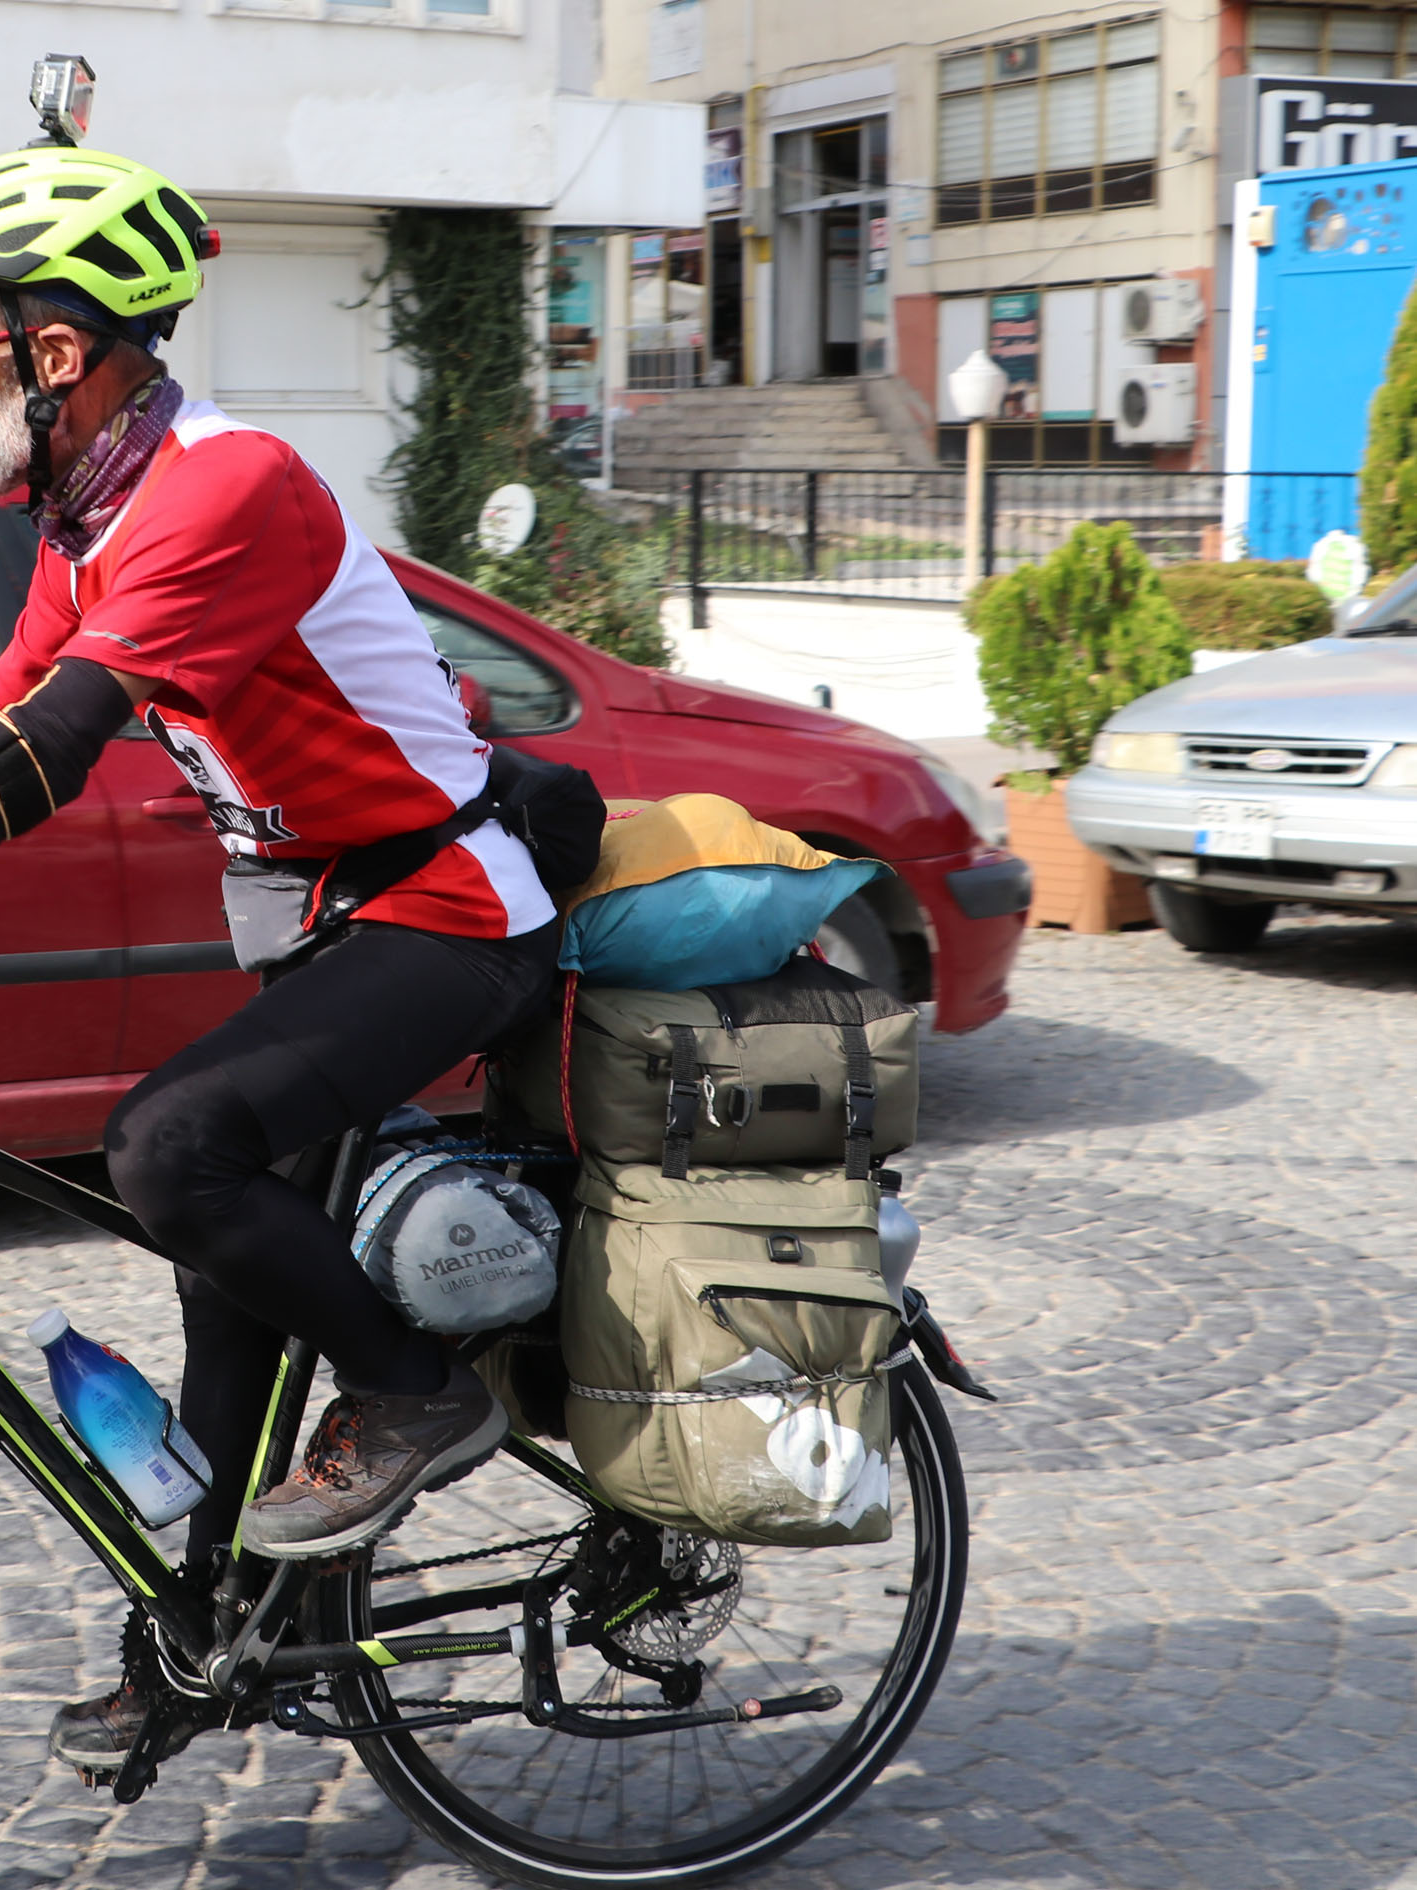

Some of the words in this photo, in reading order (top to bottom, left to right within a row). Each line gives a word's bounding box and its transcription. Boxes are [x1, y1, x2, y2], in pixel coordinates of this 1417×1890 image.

[418, 1239, 527, 1281] Marmot
[439, 1265, 514, 1296] LIMELIGHT
[603, 1587, 660, 1632] MOSSO
